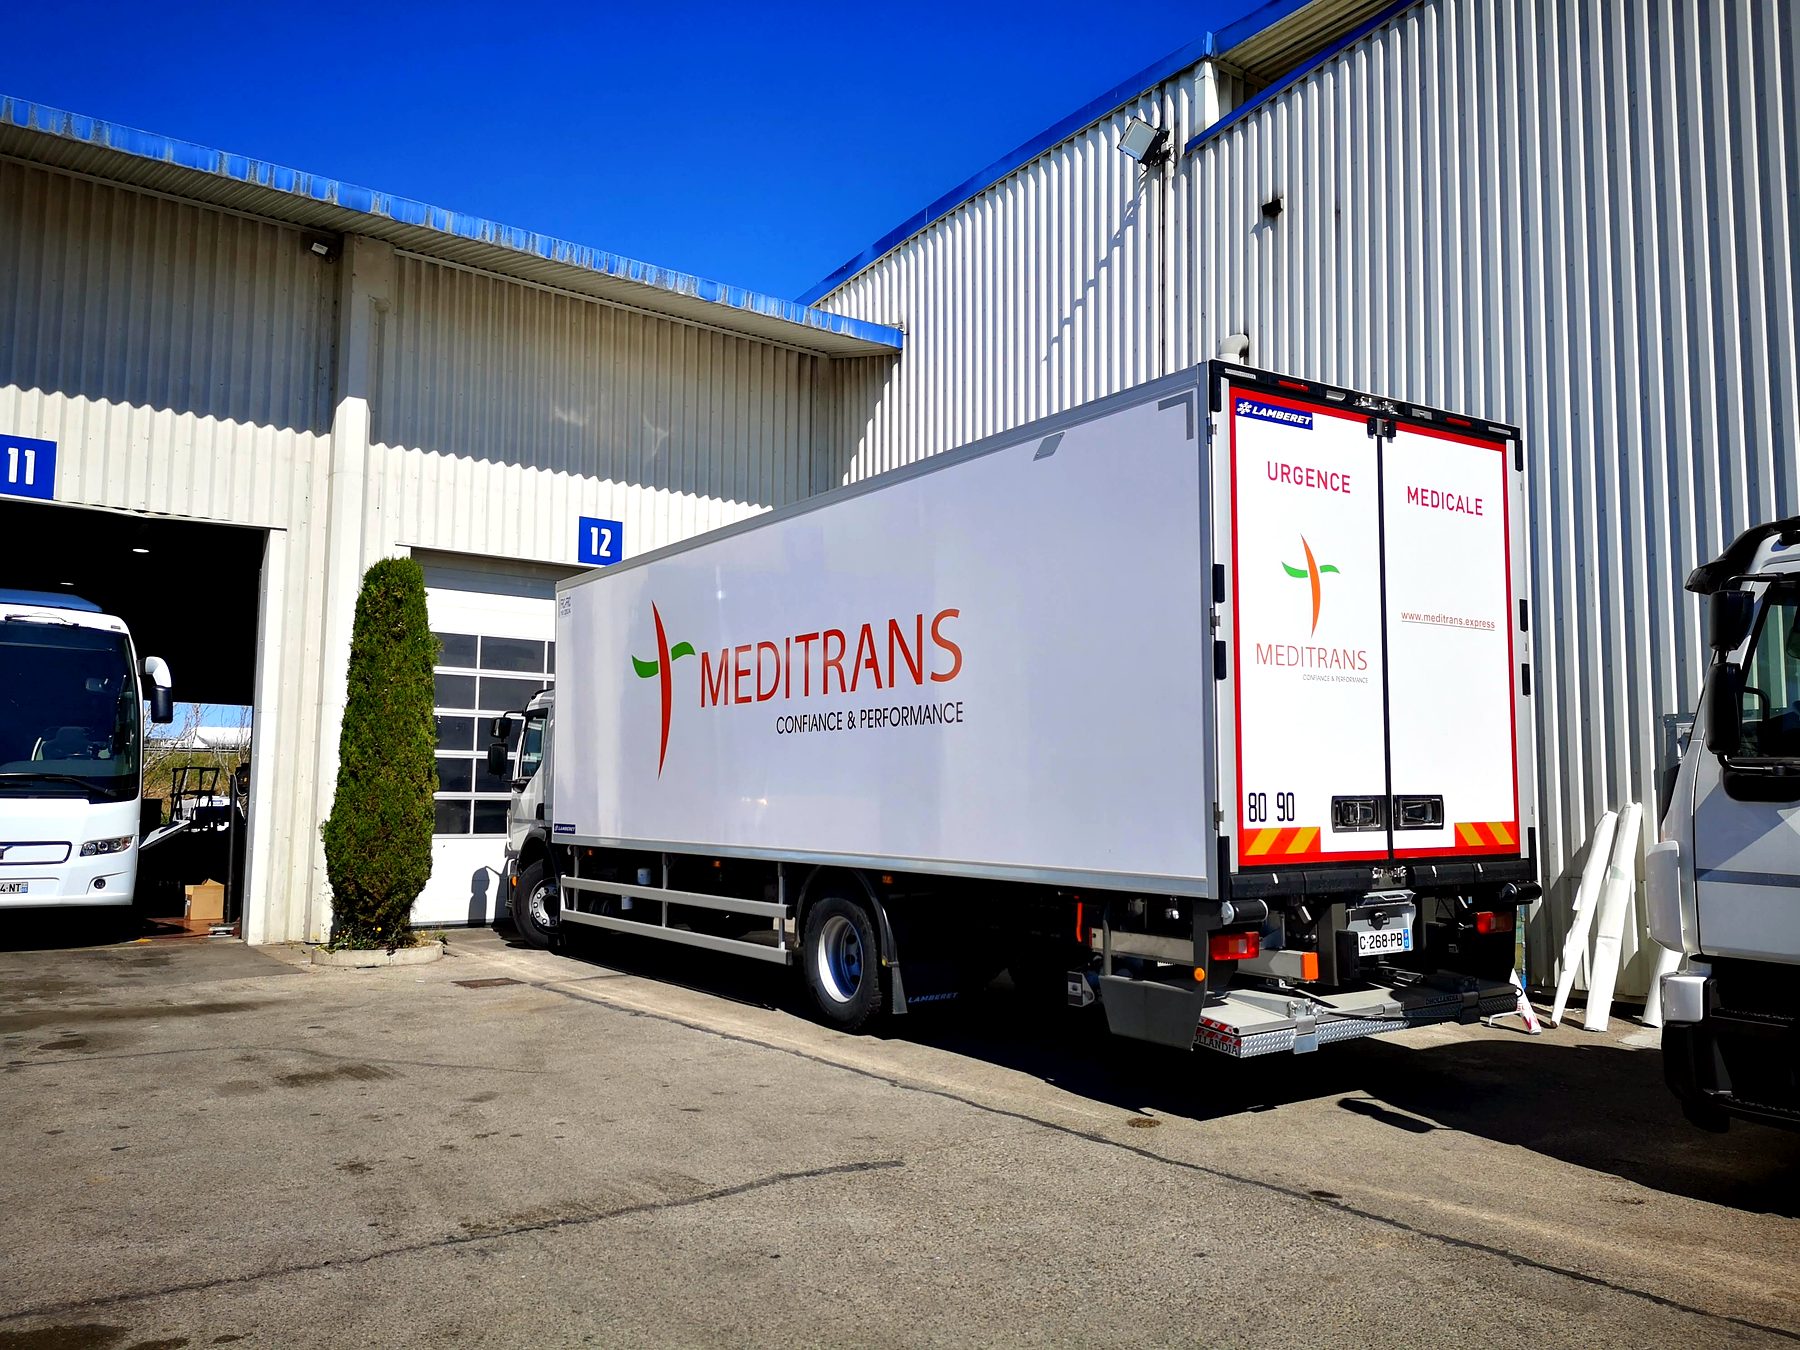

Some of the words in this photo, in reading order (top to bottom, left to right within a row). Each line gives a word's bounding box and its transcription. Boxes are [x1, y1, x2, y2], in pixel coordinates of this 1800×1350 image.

[1252, 406, 1312, 425] LAMBERET
[8, 447, 36, 485] 11
[1267, 460, 1351, 494] URGENCE
[1407, 485, 1484, 516] MEDICALE
[590, 526, 611, 557] 12
[1400, 611, 1496, 630] www.meditrans.express
[700, 608, 963, 708] MEDITRANS
[1256, 643, 1368, 671] MEDITRANS
[776, 711, 843, 735] CONFIANCE
[847, 710, 857, 730] &
[860, 701, 964, 729] PERFORMANCE
[1248, 792, 1267, 822] 80
[1276, 791, 1295, 822] 90
